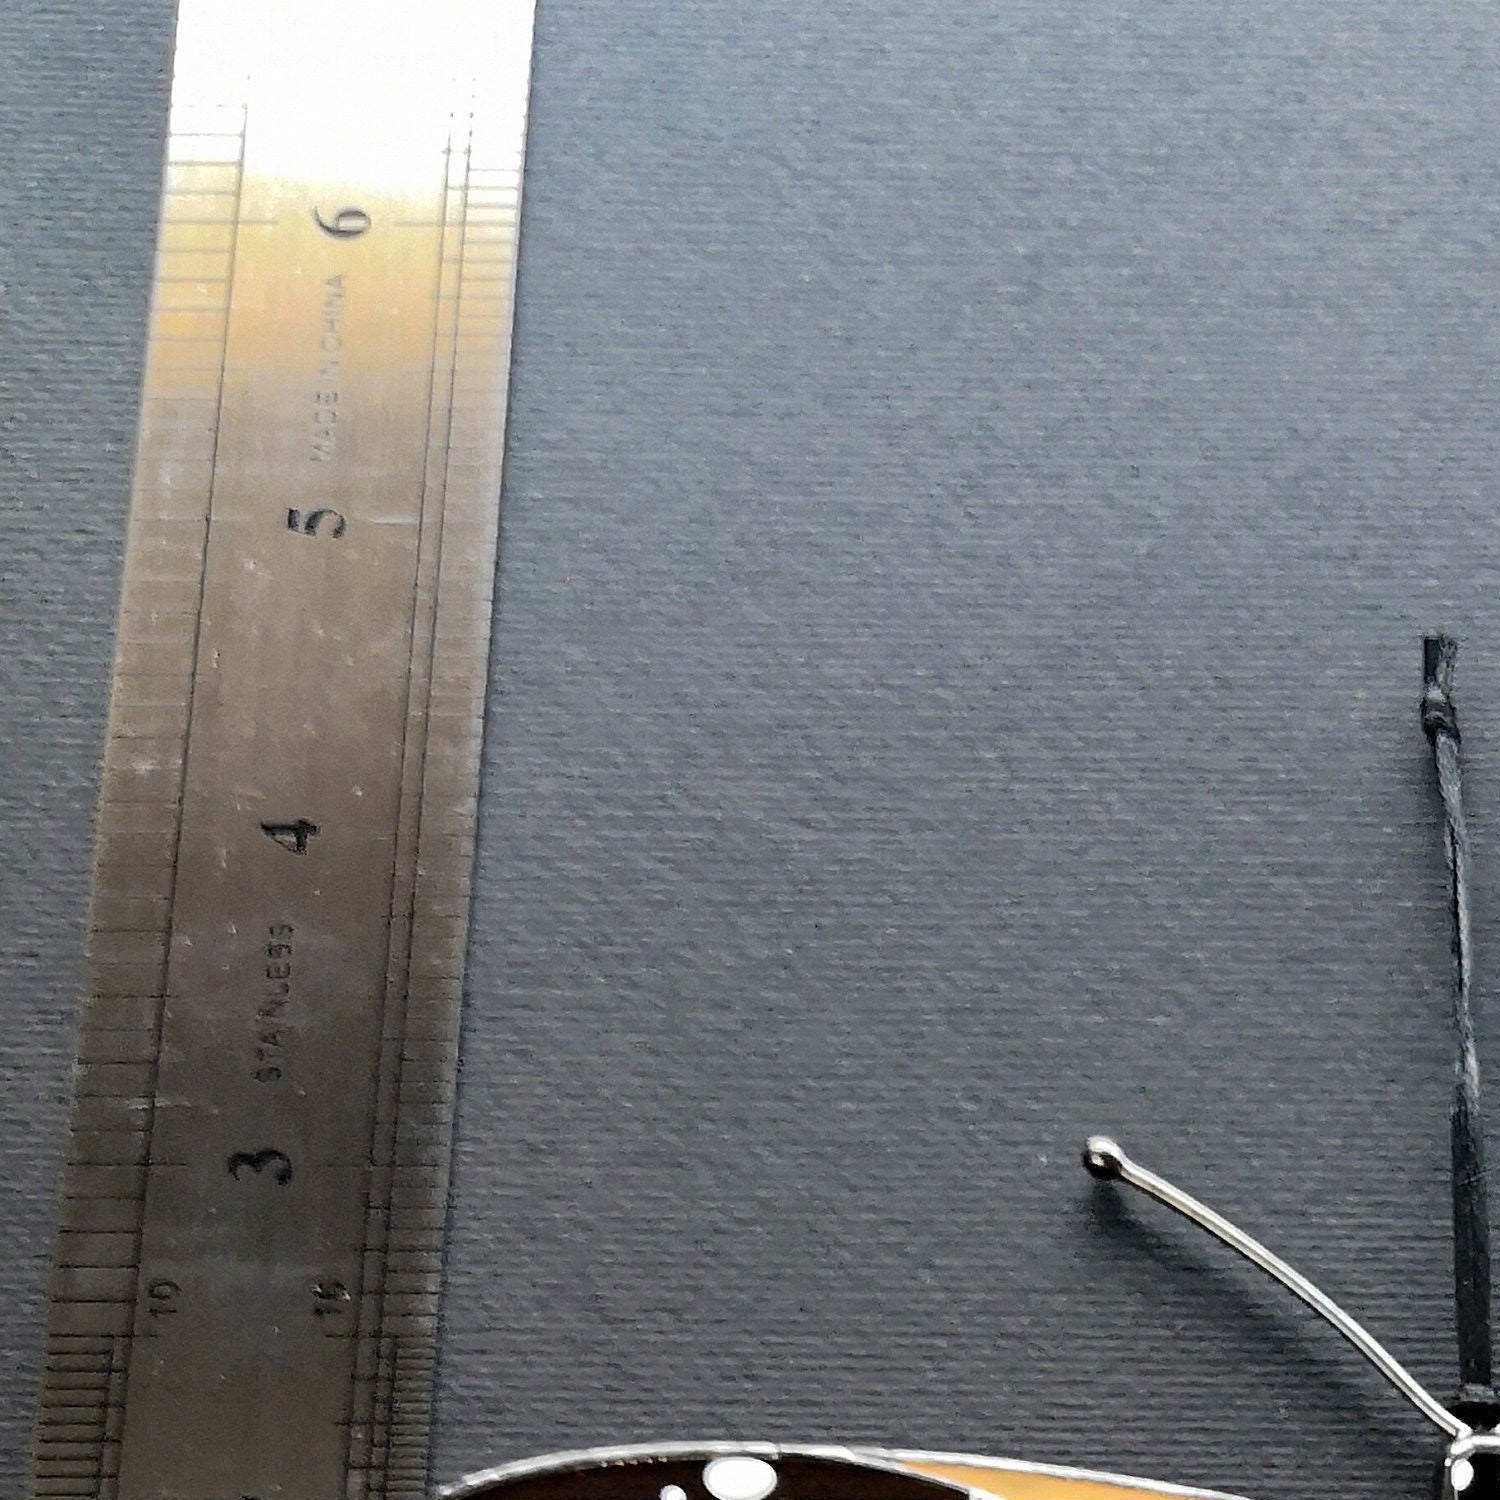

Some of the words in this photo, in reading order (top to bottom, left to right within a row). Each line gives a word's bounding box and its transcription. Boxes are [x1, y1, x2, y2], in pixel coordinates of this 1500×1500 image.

[312, 205, 372, 240] 6
[286, 506, 347, 540] 5
[260, 818, 321, 855] 4
[227, 1147, 293, 1187] 3
